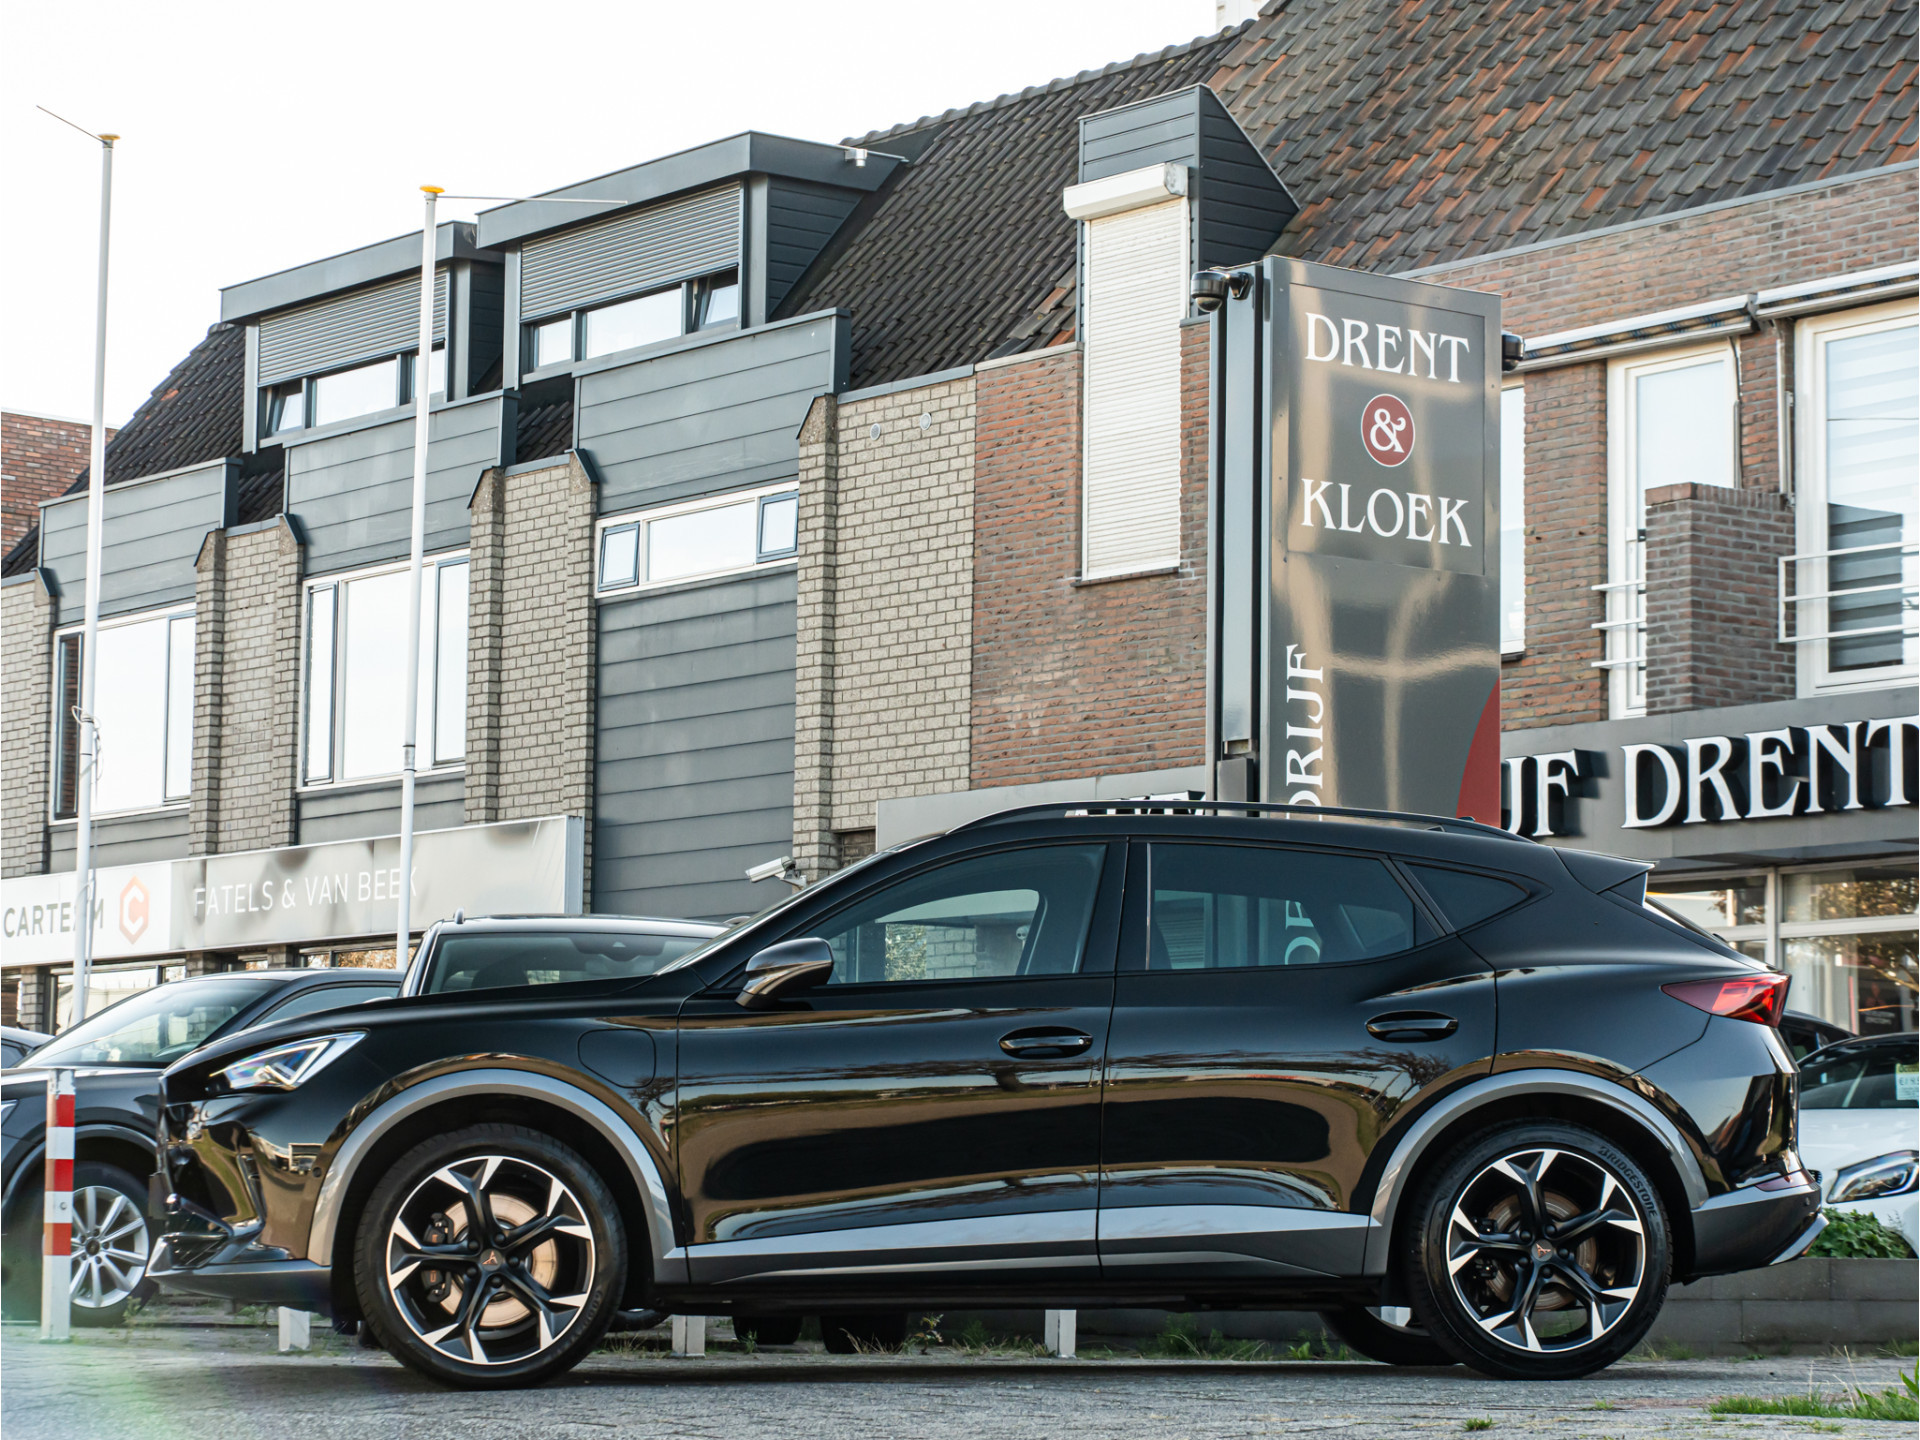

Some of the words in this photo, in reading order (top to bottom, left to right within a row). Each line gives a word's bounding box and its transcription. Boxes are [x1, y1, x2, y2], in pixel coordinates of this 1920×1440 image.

[1304, 311, 1470, 384] DRENT
[1369, 406, 1408, 455] &
[1300, 477, 1473, 548] KLOEK
[1620, 713, 1919, 830] DRENT
[3, 897, 105, 939] CARTEM
[281, 877, 297, 910] &
[304, 872, 349, 907] VAN
[1598, 1145, 1659, 1218] BRIDGESTONE
